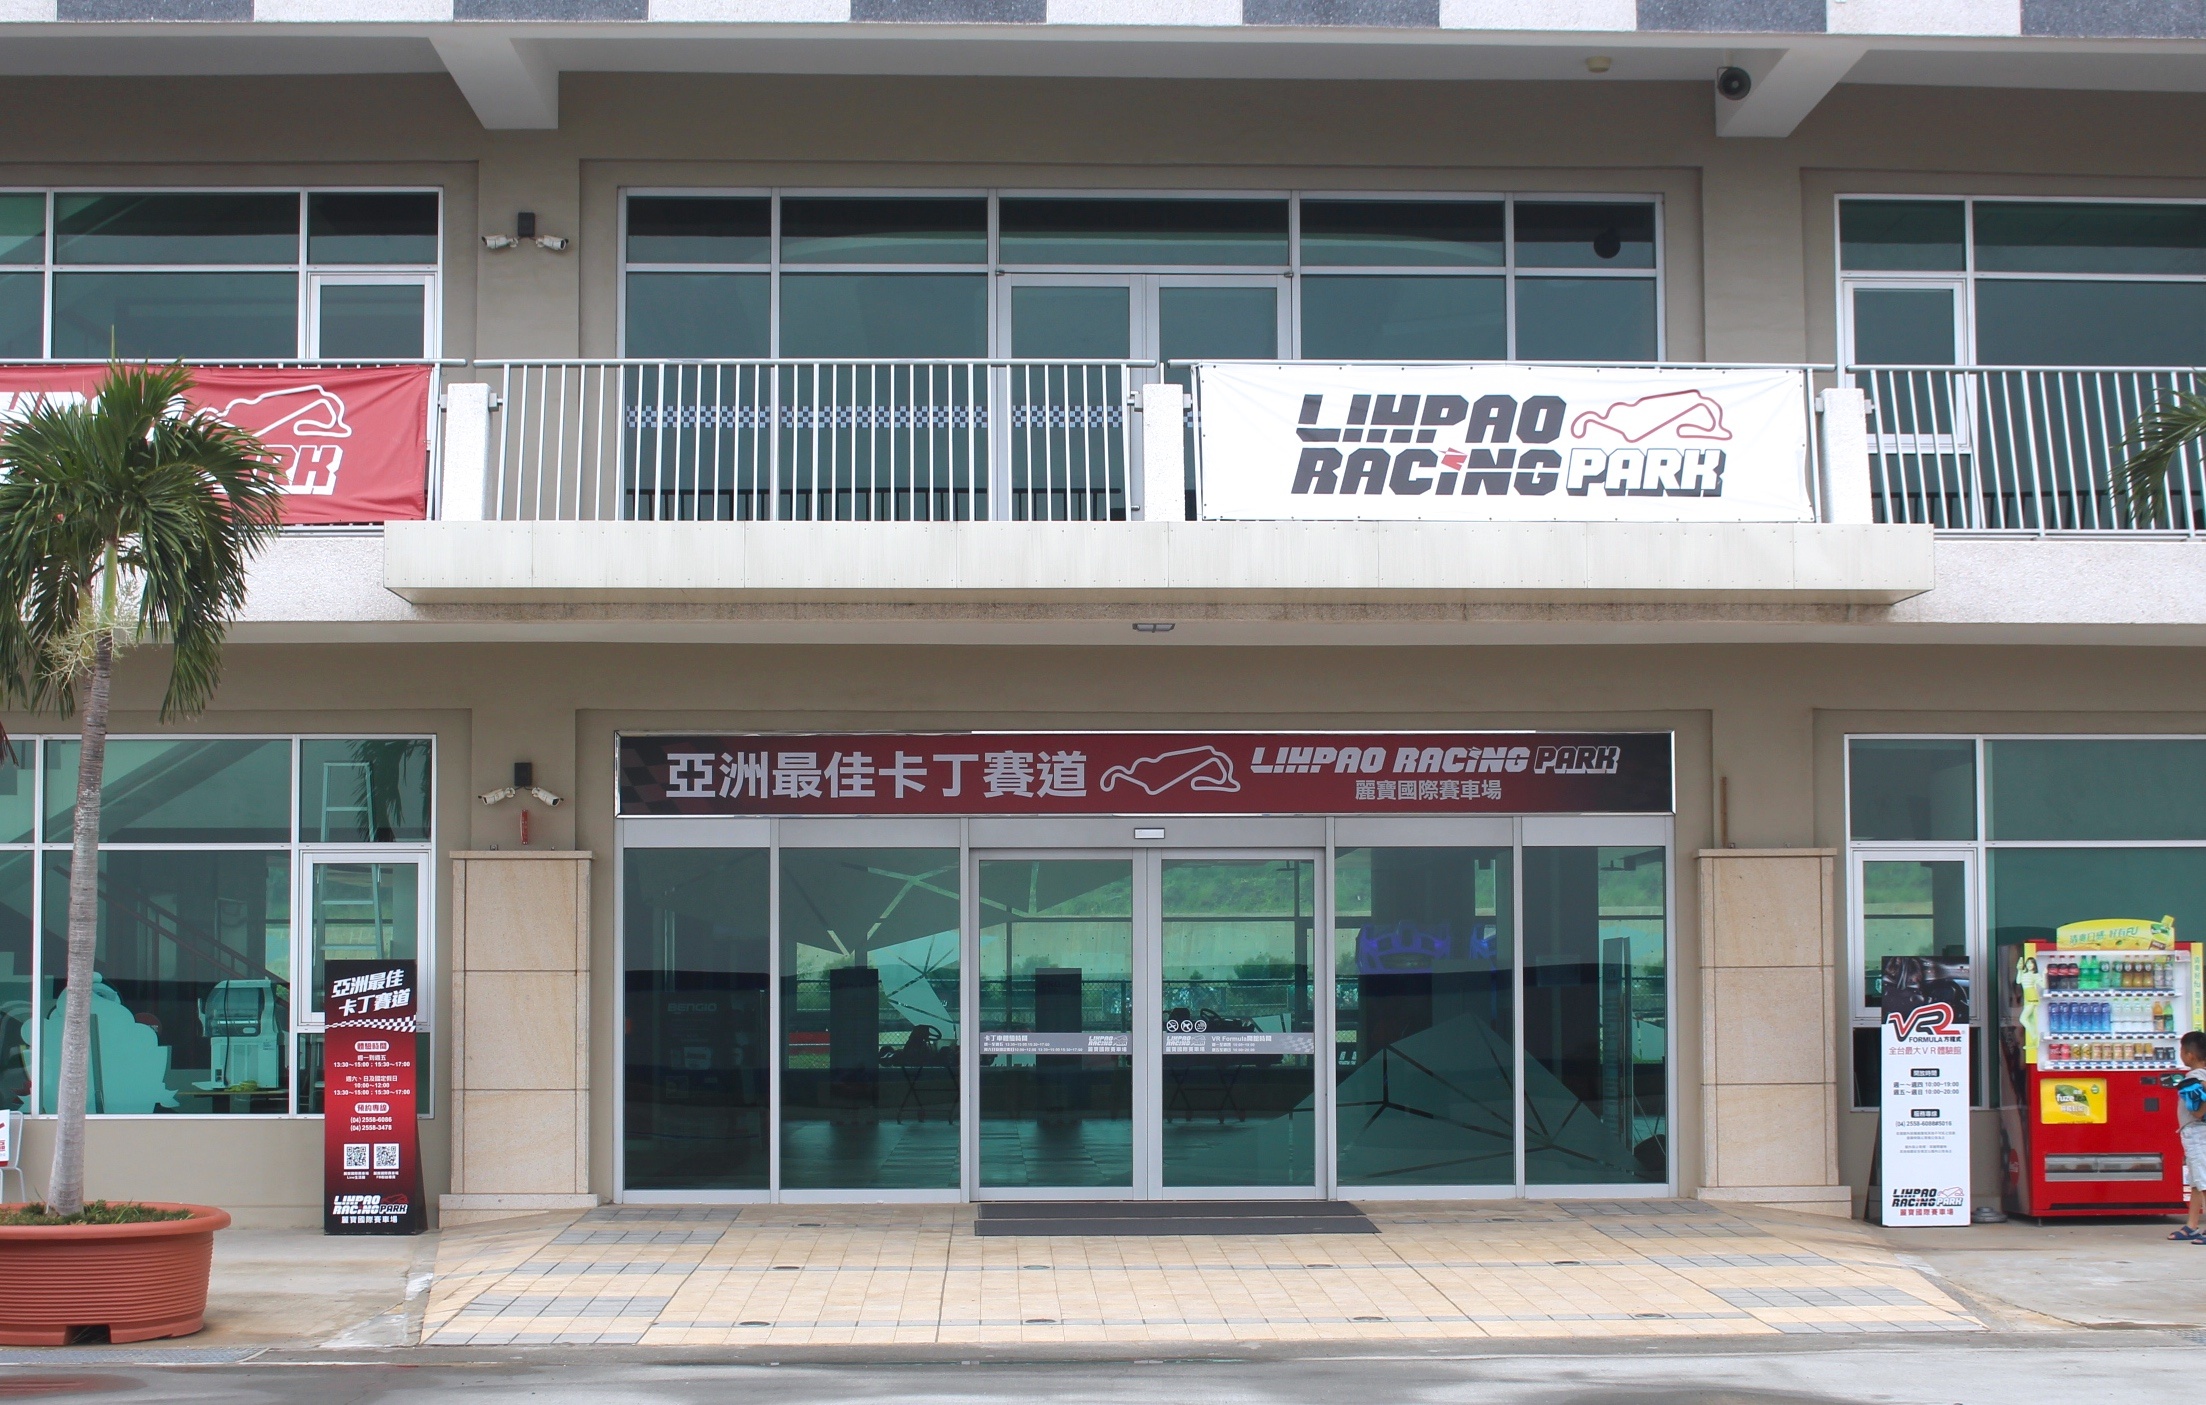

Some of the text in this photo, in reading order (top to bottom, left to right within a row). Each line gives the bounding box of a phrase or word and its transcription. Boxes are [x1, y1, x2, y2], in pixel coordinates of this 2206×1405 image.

[1291, 447, 1727, 498] RACING PARK
[665, 750, 1087, 798] 亞洲最佳卡丁賽道
[1393, 745, 1530, 774] RACING
[1534, 745, 1621, 775] PARK
[1355, 779, 1502, 801] 麗寶國際賽車場
[331, 968, 405, 999] 亞洲最佳
[338, 987, 411, 1017] 卡丁賽道
[1887, 1002, 1961, 1042] VR
[379, 1203, 408, 1215] PARK
[1936, 1197, 1964, 1207] PARK
